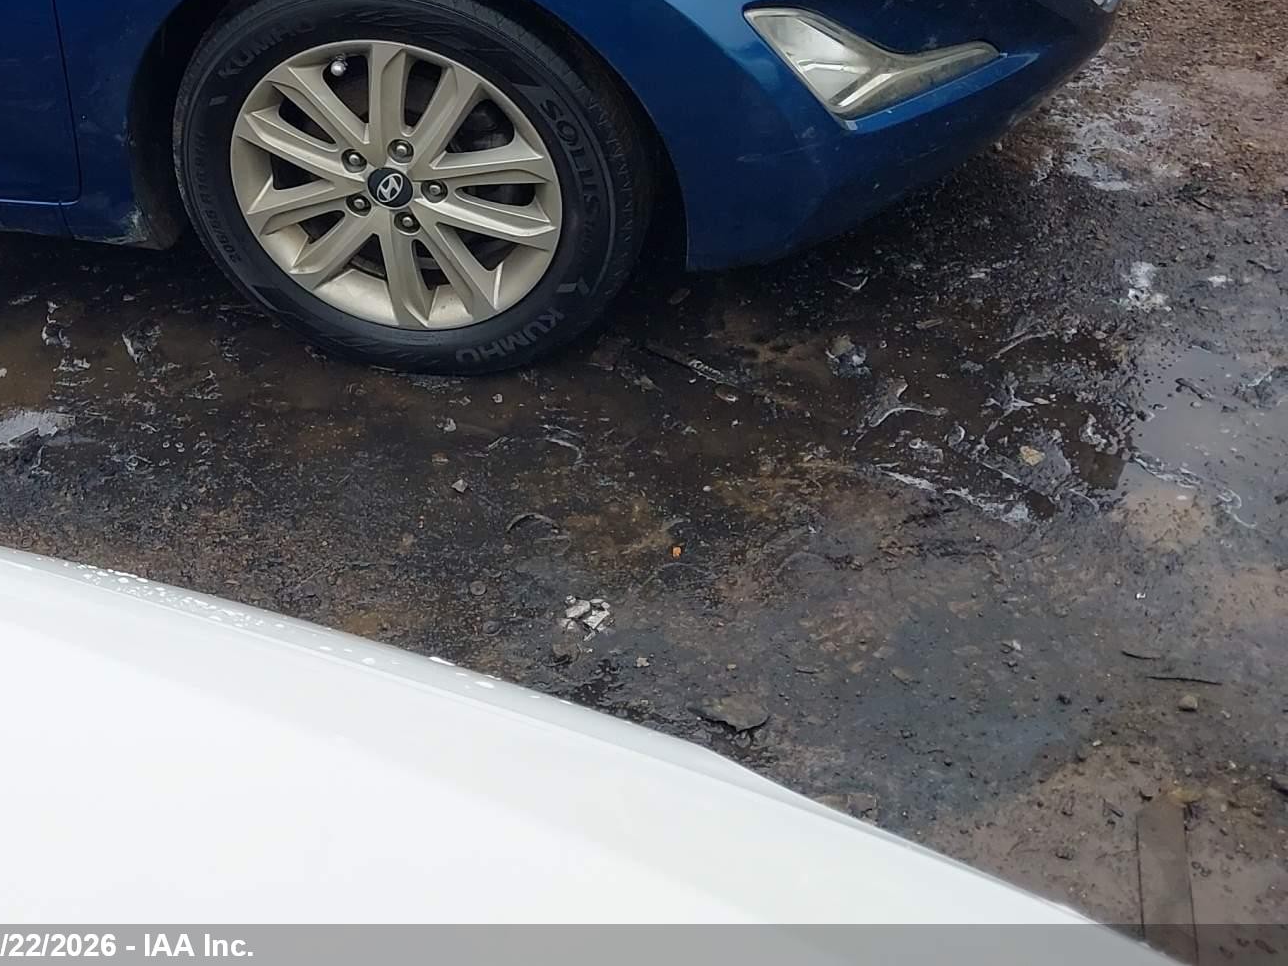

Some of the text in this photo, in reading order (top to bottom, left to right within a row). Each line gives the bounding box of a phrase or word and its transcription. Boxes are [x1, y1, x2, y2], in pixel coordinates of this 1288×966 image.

[216, 18, 316, 78] KUMHO
[539, 98, 601, 216] SOLUS
[455, 306, 567, 364] KUMHO
